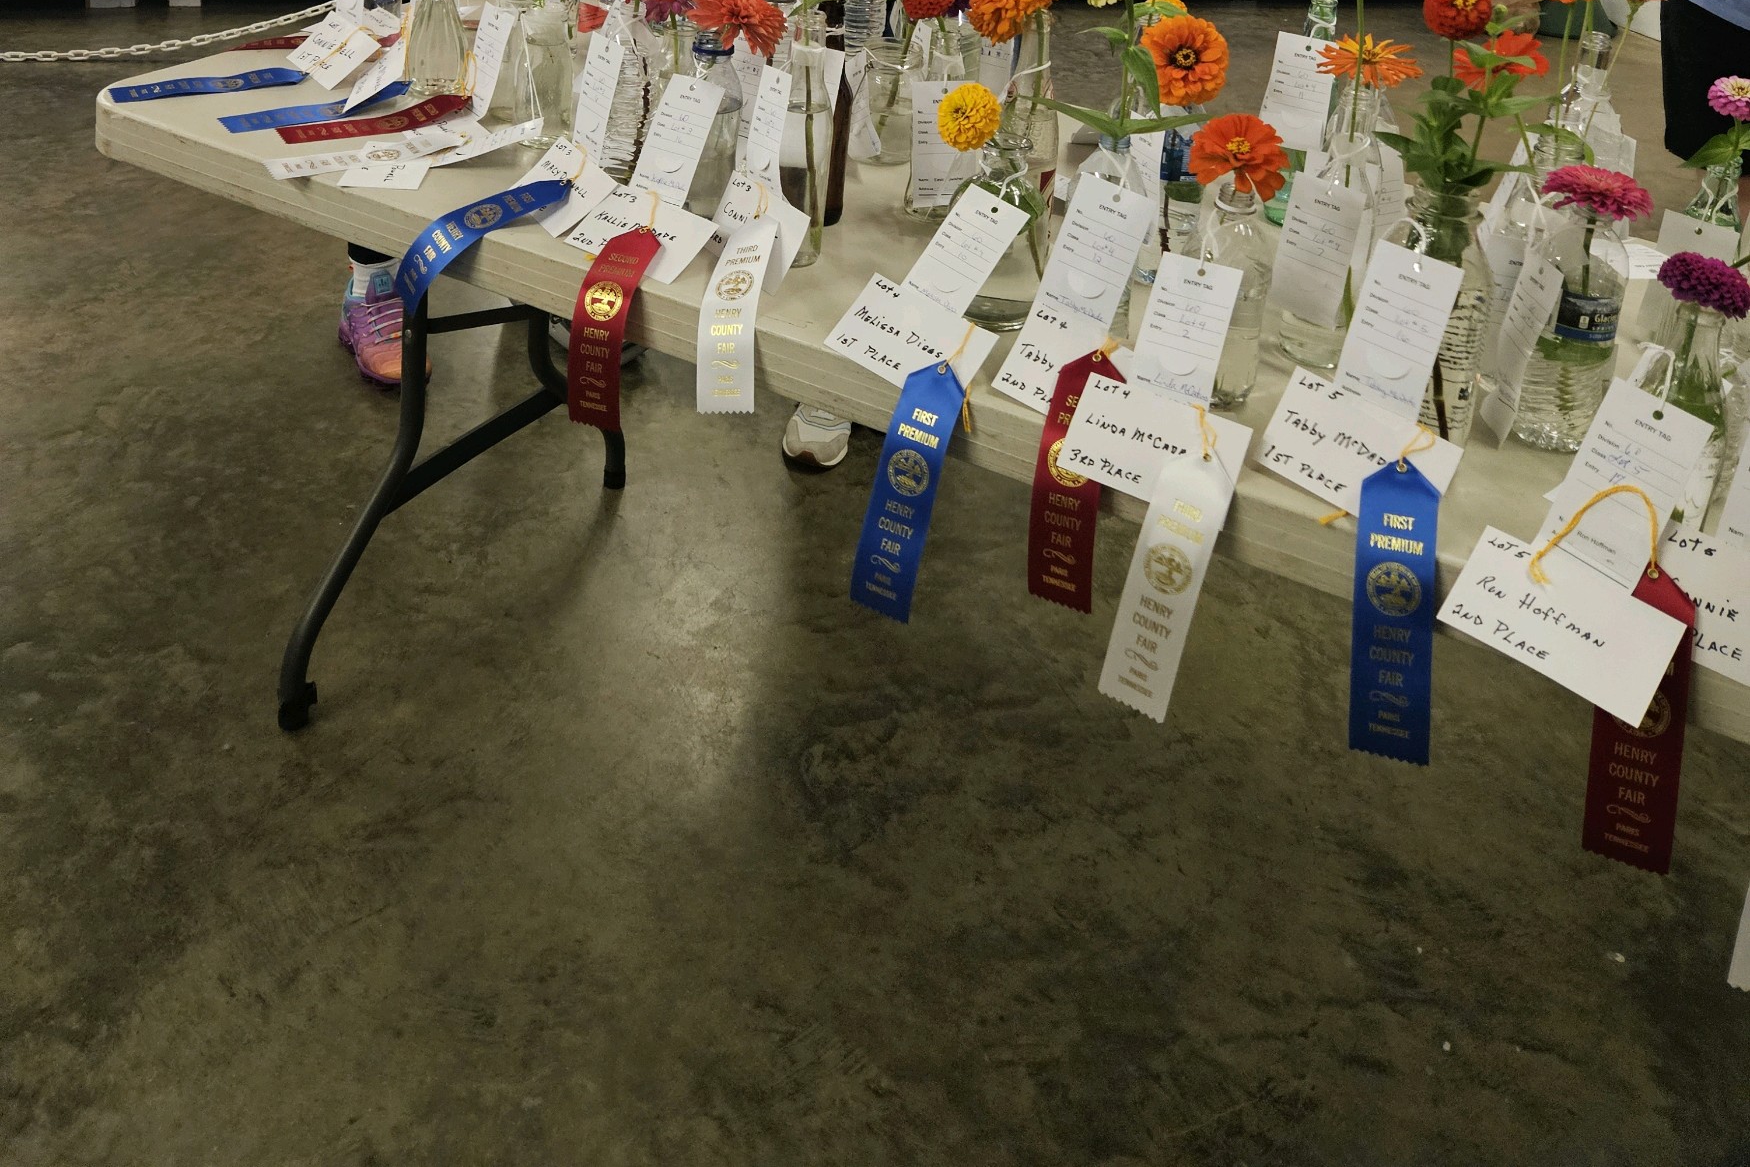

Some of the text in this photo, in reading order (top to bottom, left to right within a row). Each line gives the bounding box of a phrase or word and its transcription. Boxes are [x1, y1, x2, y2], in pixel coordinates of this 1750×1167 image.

[1294, 52, 1308, 60] ENTRY
[555, 142, 568, 152] LOT
[613, 190, 638, 203] LOT 3
[723, 201, 751, 225] CONNI
[1099, 204, 1128, 220] ENTRY TAG
[1314, 198, 1341, 212] ENTRY TAG
[975, 209, 998, 225] ENTRY TAG
[1071, 220, 1089, 231] Division
[432, 230, 452, 254] COUNTY
[1066, 232, 1079, 241] Class
[423, 245, 437, 262] FAIR
[736, 244, 759, 256] THIRD
[1062, 244, 1074, 253] Entry
[608, 252, 639, 264] SECOND
[725, 255, 761, 267] PREMIUM
[598, 264, 635, 278] PREMIUM
[1398, 273, 1418, 285] ENTRY
[876, 279, 892, 293] LOT
[908, 280, 919, 289] Name
[1183, 278, 1214, 291] ENTRY TAG
[1045, 291, 1059, 301] Name
[1156, 298, 1176, 307] Division
[714, 307, 742, 318] HENRY
[1036, 310, 1057, 324] LOT
[1153, 310, 1166, 318] Class
[711, 324, 743, 336] COUNTY
[1149, 323, 1190, 339] Entry 2
[1360, 319, 1374, 328] Entry
[583, 326, 610, 341] HENRY
[580, 342, 610, 359] COUNTY
[717, 342, 735, 353] FAIR
[863, 345, 902, 370] PLACE
[585, 360, 603, 374] FAIR
[1001, 372, 1026, 391] 2ND
[1137, 374, 1151, 383] Name
[1094, 379, 1130, 399] LOT 4
[1299, 376, 1344, 400] LOT 5
[912, 407, 938, 427] FIRST
[897, 423, 940, 449] PREMIUM
[1634, 418, 1672, 442] ENTRY TAG
[1333, 432, 1388, 466] McDAD
[1597, 433, 1620, 449] Division
[1591, 447, 1606, 459] Class
[1069, 448, 1143, 484] 3RD PLACE
[1264, 444, 1347, 493] 1ST PLACE
[1584, 461, 1600, 473] Entry
[1048, 491, 1081, 511] HENRY
[885, 499, 915, 520] HENRY
[878, 516, 914, 540] COUNTY
[1044, 509, 1082, 531] COUNTY
[1383, 512, 1416, 531] FIRST
[880, 538, 901, 556] FAIR
[1051, 532, 1072, 548] FAIR
[1369, 532, 1424, 556] PREMIUM
[1488, 537, 1532, 559] LOT 5
[1576, 531, 1617, 555] Ron Hoffman
[1139, 594, 1173, 620] HENRY
[1132, 611, 1172, 640] COUNTY
[1452, 603, 1551, 660] 2ND PLACE
[1374, 624, 1411, 644] HENRY
[1136, 635, 1157, 654] FAIR
[1369, 645, 1414, 667] COUNTY
[1378, 670, 1404, 688] FAIR
[1615, 741, 1657, 765] HENRY
[1608, 762, 1660, 788] COUNTY
[1618, 786, 1646, 806] FAIR
